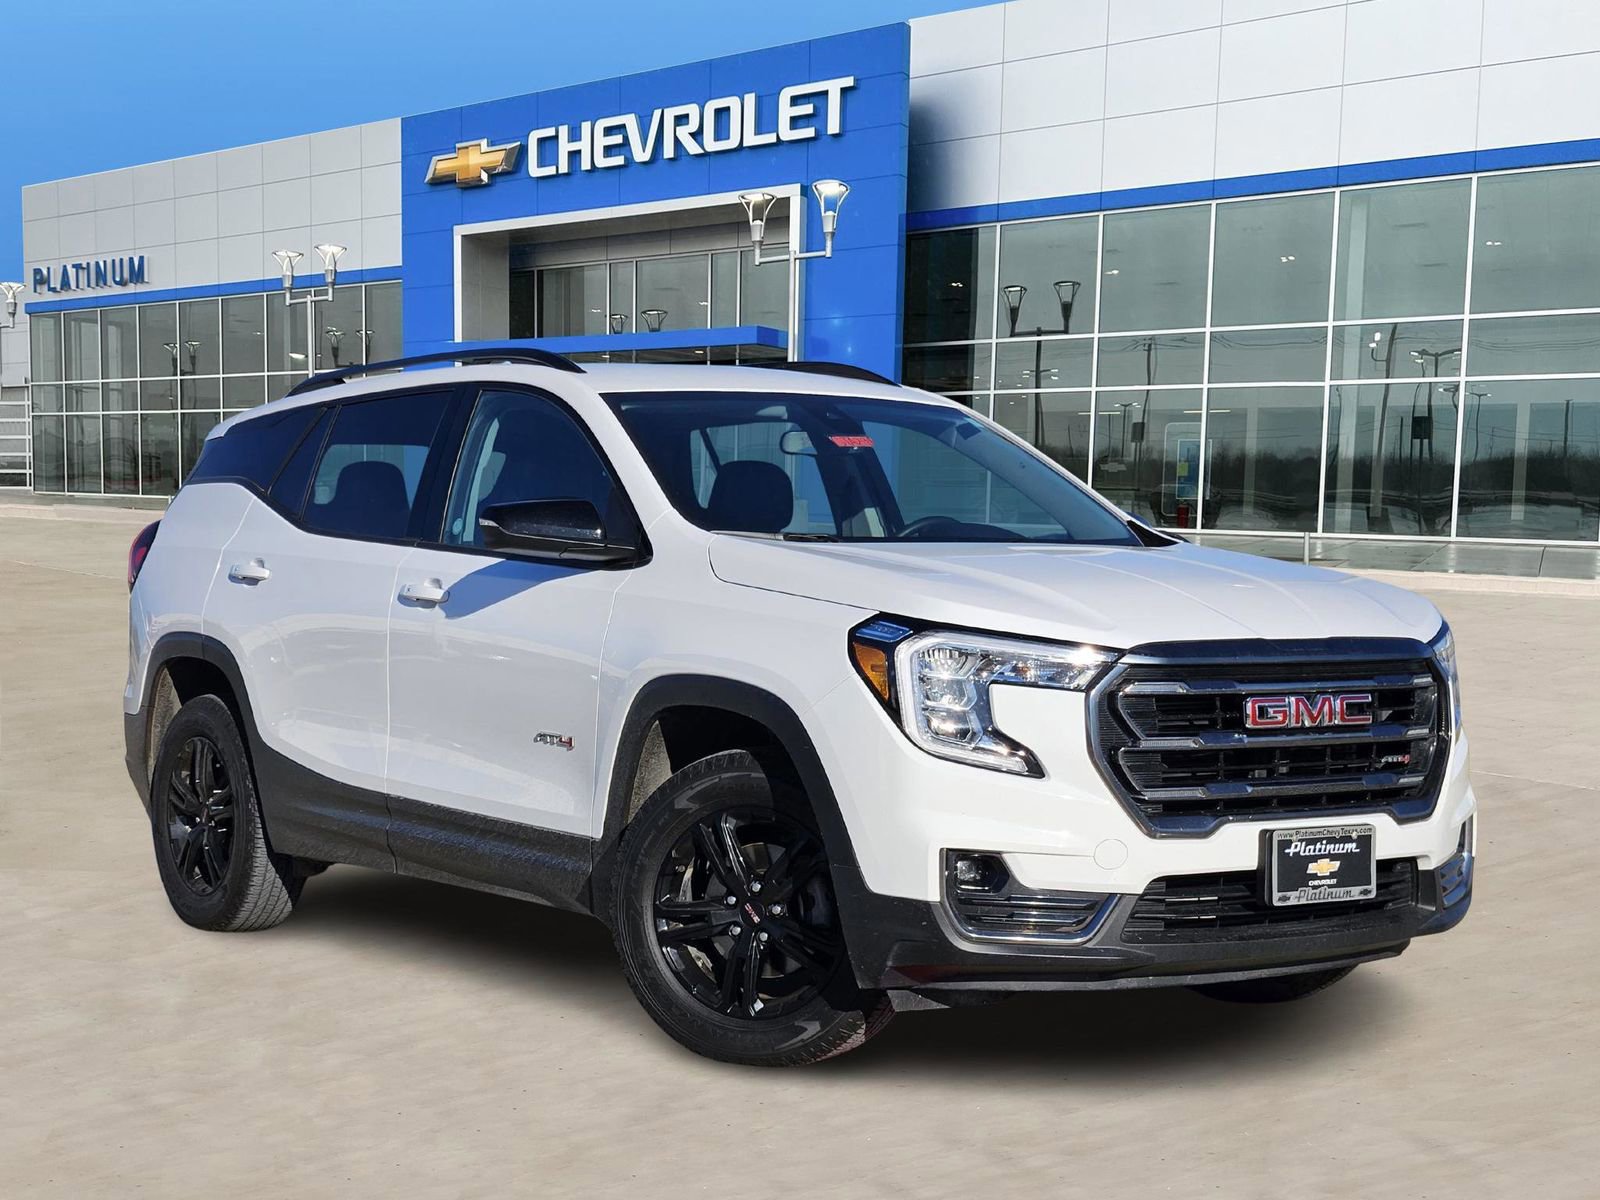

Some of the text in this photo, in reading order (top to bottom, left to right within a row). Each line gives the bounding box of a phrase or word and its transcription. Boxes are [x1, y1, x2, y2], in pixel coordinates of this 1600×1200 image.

[527, 75, 856, 178] CHEVROLET
[32, 255, 146, 294] PLATINUM
[1244, 693, 1373, 729] GMC
[1277, 827, 1373, 839] wwwPlatinumChevyTexas.com
[1284, 840, 1360, 857] Platinum
[1294, 886, 1355, 902] Platinum
